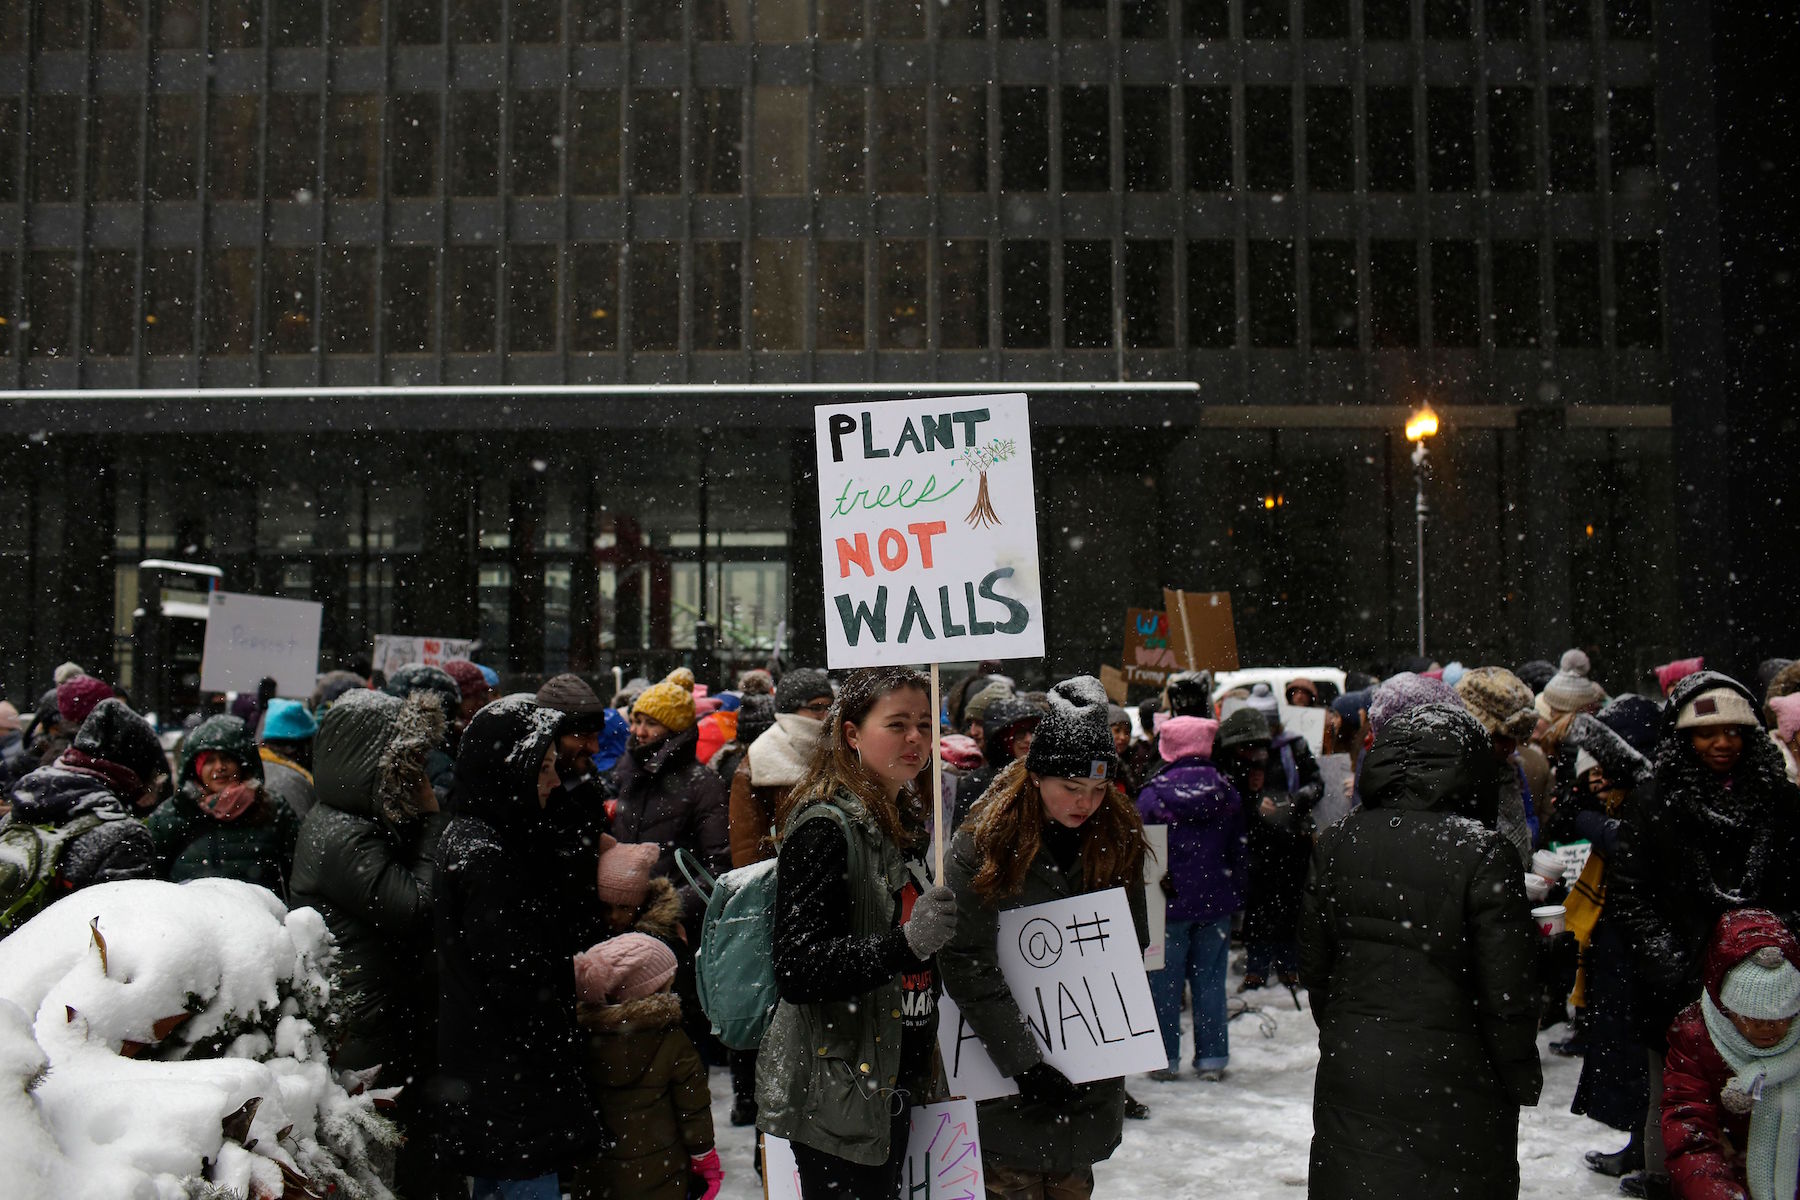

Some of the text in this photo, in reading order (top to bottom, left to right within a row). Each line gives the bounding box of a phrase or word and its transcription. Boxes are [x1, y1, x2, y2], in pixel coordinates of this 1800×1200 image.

[829, 408, 990, 462] PLANT
[831, 474, 964, 518] trees
[835, 520, 947, 578] NOT
[834, 567, 1029, 646] WALLS
[424, 639, 441, 655] NO
[1135, 646, 1180, 668] WA
[1125, 665, 1165, 685] Trump
[1019, 911, 1110, 968] @#
